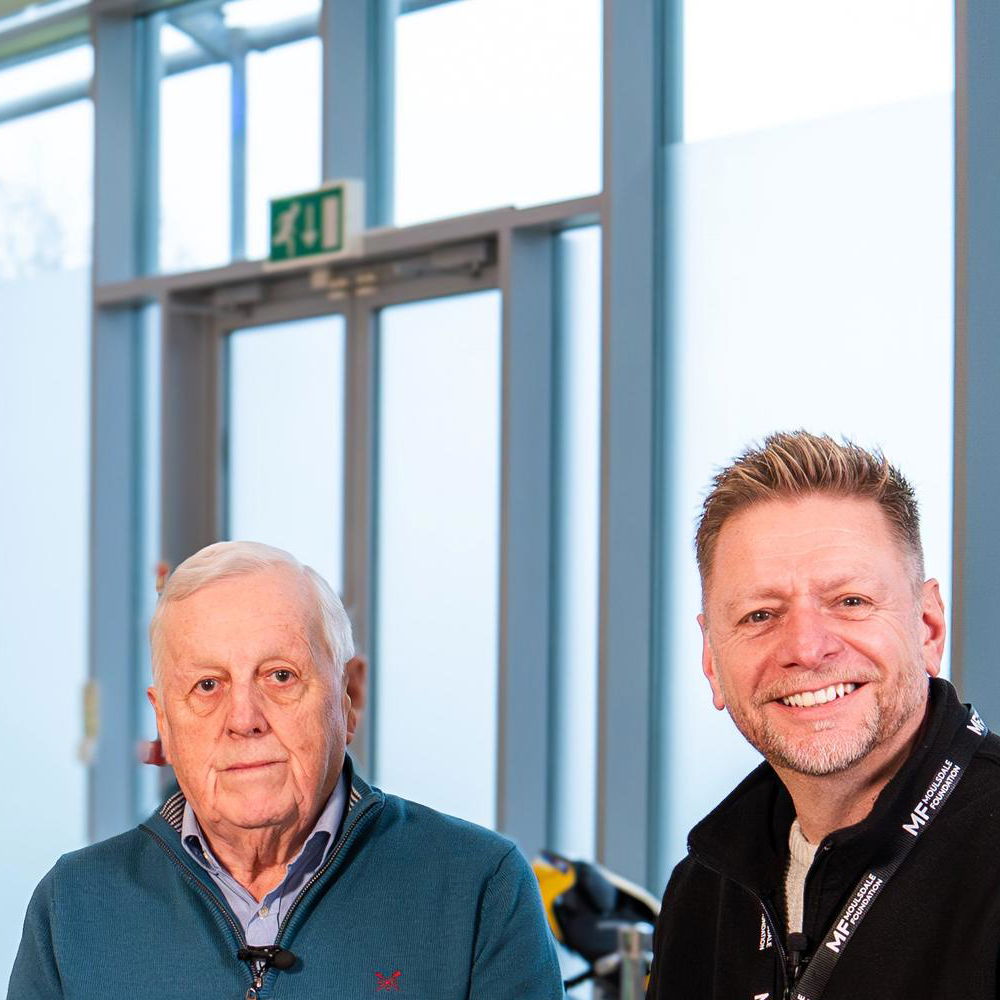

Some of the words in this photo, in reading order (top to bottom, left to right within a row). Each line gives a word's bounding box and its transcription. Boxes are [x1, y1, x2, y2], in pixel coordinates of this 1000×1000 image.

[921, 759, 953, 805] MOULSDALE
[929, 764, 961, 810] FOUNDATION
[902, 801, 930, 836] MF
[843, 873, 877, 920] MOULSDALE
[849, 878, 883, 925] FOUNDATION
[825, 918, 850, 953] MF
